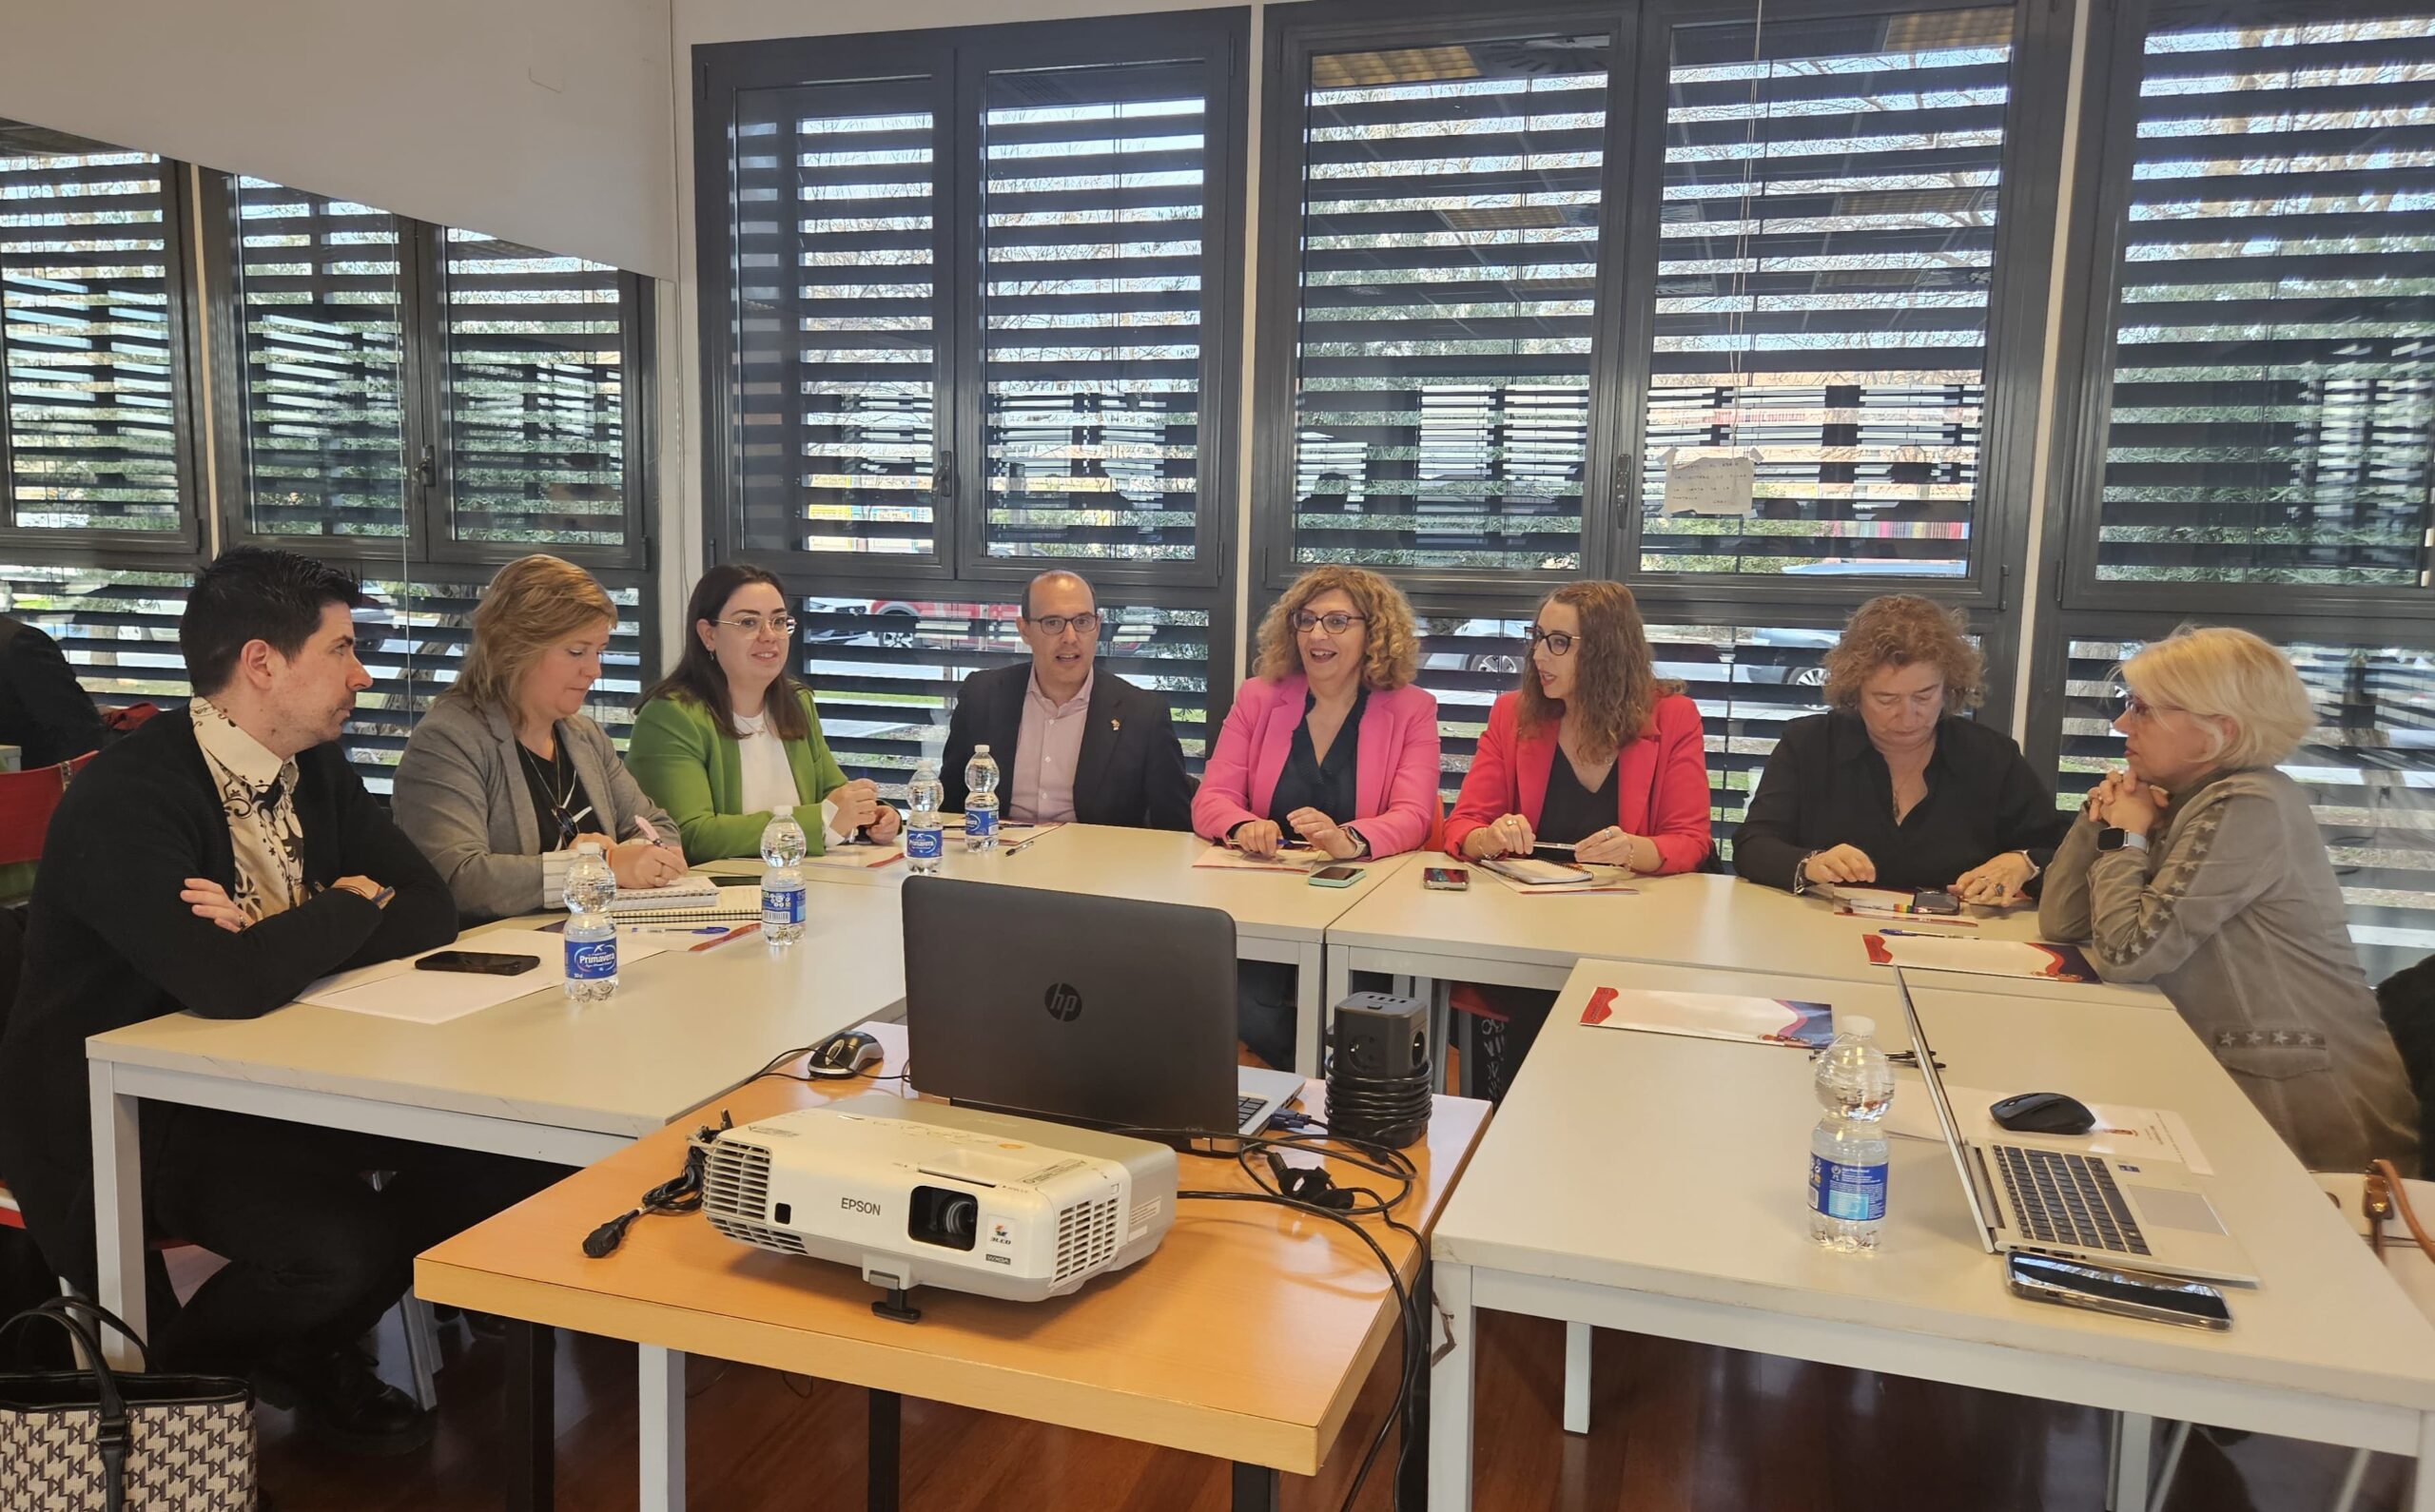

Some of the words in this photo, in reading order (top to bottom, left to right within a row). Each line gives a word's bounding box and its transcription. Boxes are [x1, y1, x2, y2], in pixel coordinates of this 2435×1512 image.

[579, 953, 614, 963] Primavera
[1047, 983, 1080, 1021] hp
[841, 1197, 881, 1216] EPSON
